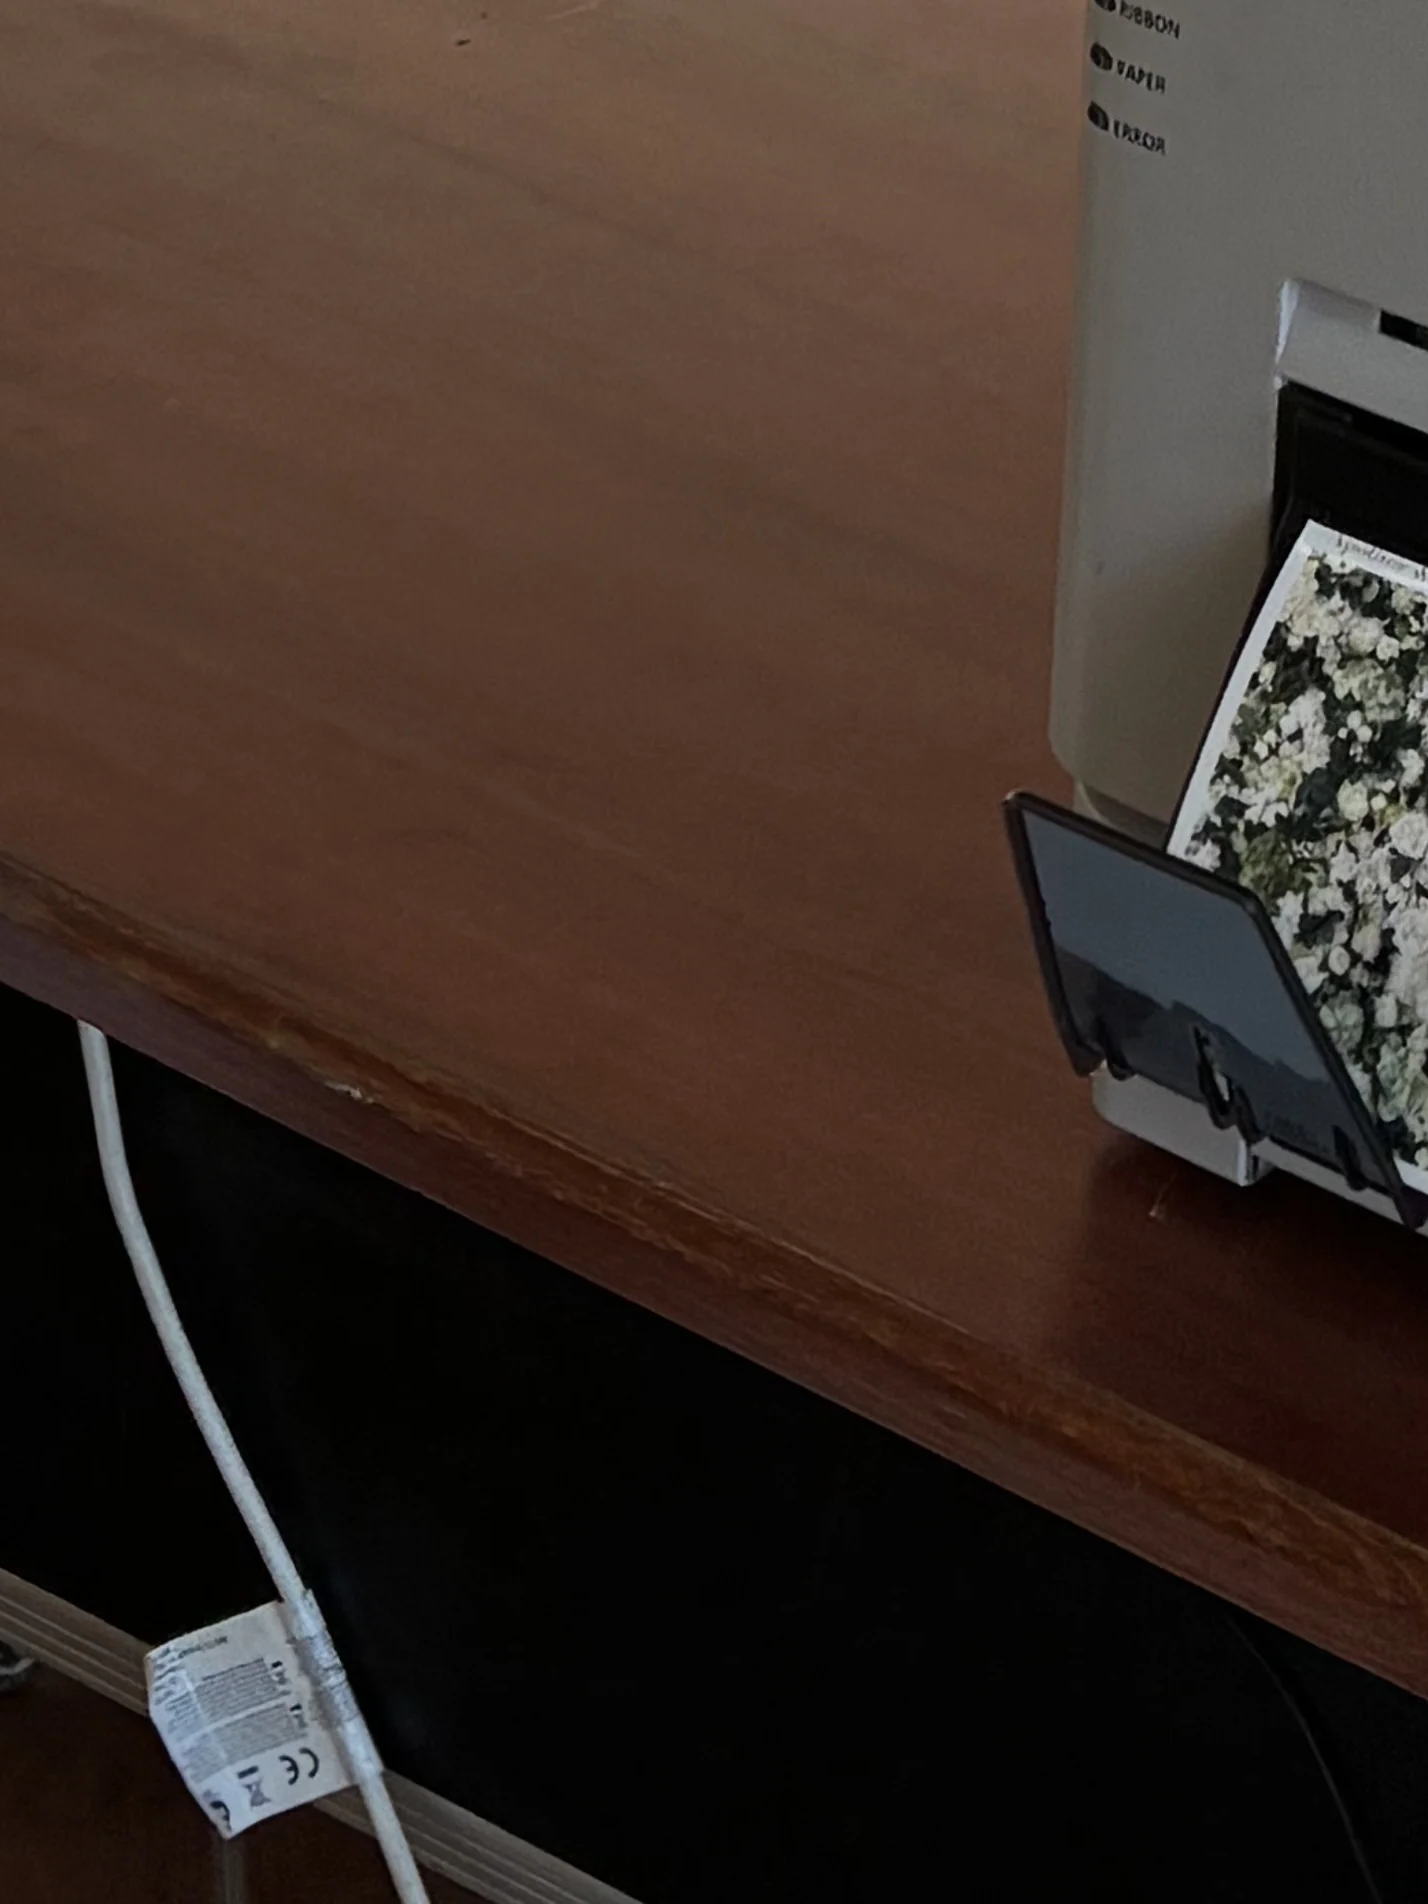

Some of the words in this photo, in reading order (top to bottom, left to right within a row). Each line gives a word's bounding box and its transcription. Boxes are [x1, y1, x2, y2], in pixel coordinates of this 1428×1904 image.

[1119, 0, 1181, 40] RIBBON
[1116, 58, 1166, 94] PAPER
[1113, 119, 1166, 156] ERROR
